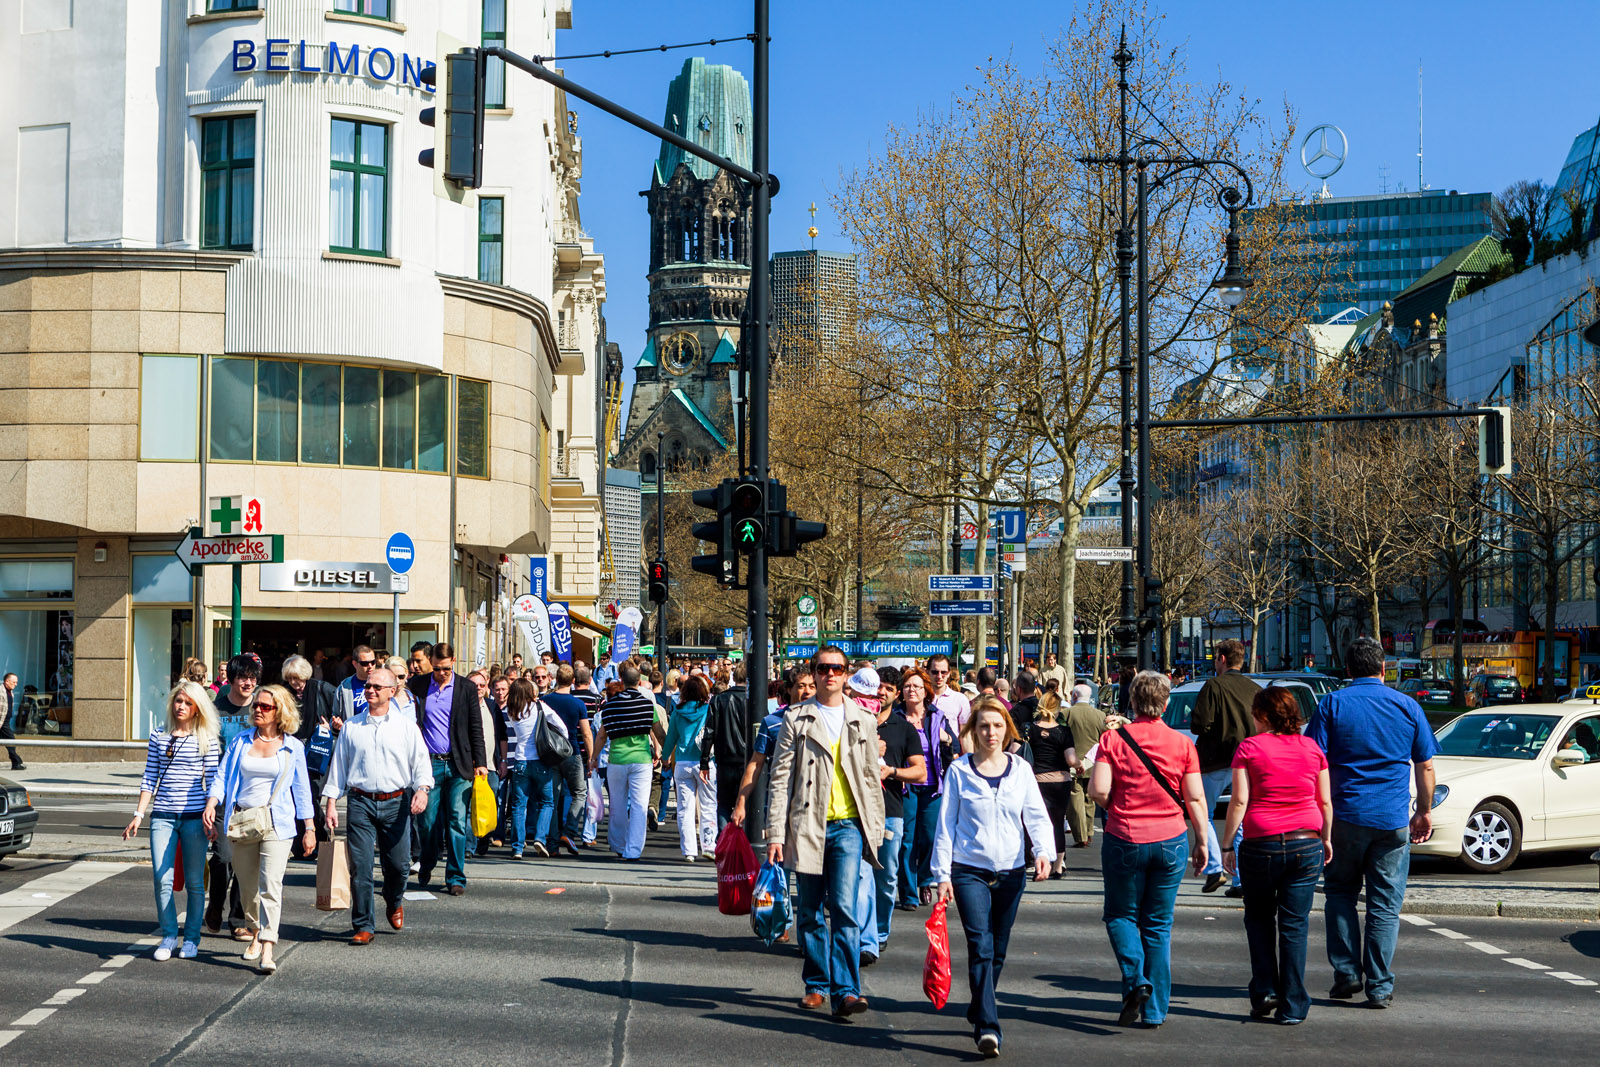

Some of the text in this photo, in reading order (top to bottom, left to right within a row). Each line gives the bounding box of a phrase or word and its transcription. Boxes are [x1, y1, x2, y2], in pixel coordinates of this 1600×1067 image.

[1001, 515, 1019, 539] U
[190, 538, 265, 559] Apotheke
[1113, 550, 1130, 558] Straße
[296, 569, 381, 584] DIESEL
[553, 616, 572, 653] DSL
[863, 641, 949, 653] Kurfürstendamm
